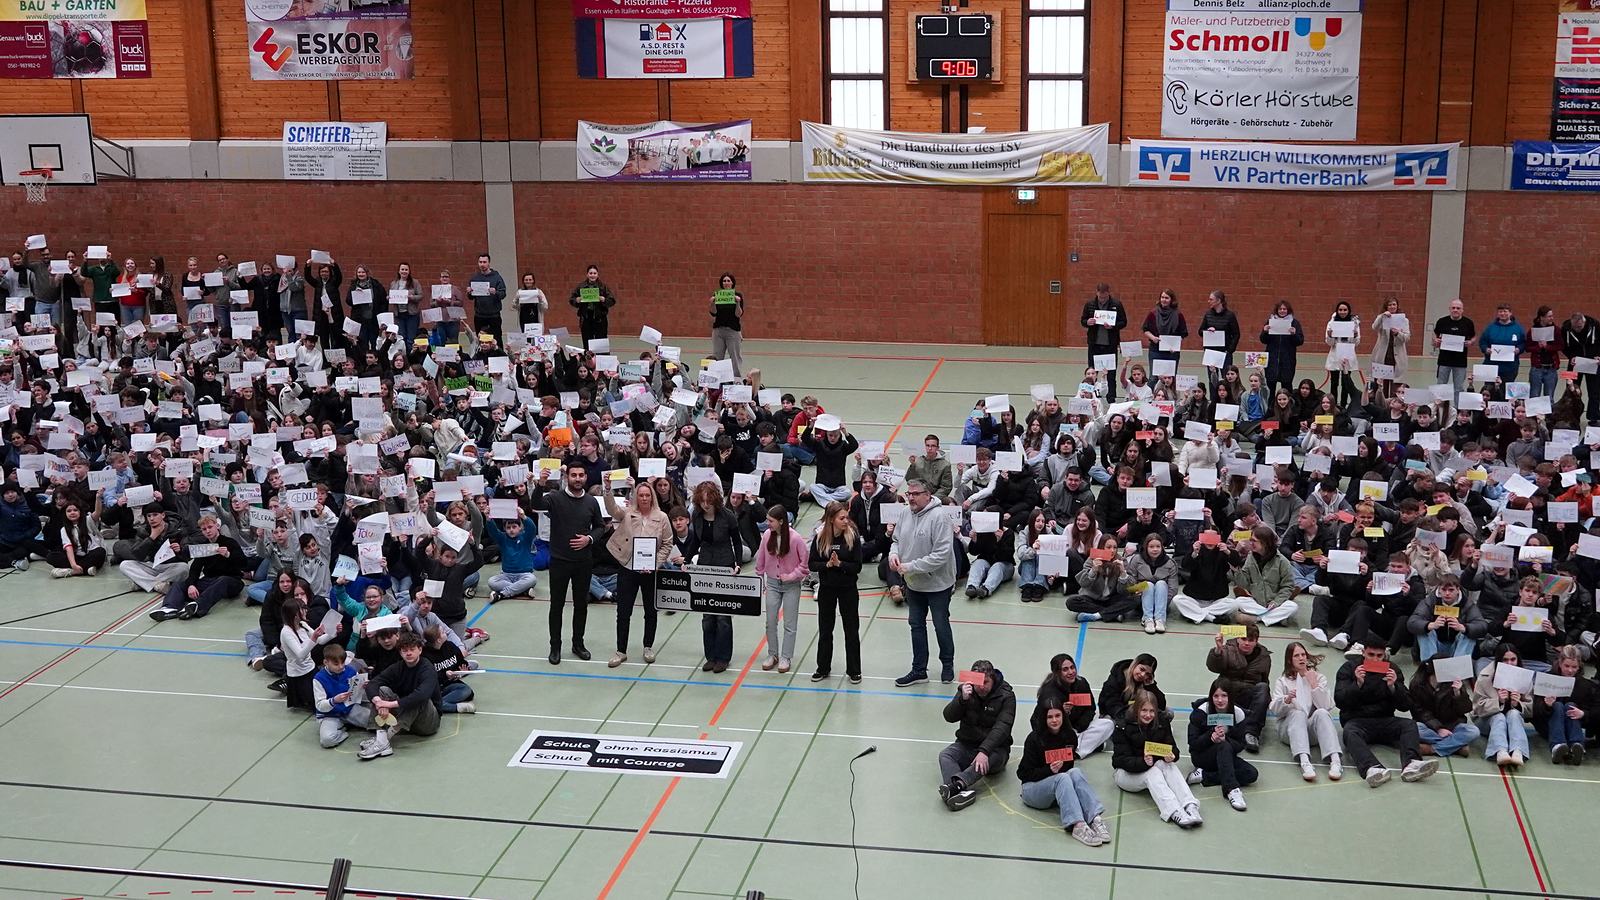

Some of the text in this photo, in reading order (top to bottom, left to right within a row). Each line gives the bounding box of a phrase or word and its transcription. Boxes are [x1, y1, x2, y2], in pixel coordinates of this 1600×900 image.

[20, 0, 45, 11] BAU
[65, 0, 116, 11] GARTEN
[693, 6, 737, 14] 05665.922379
[1193, 0, 1331, 9] Dennis Belz allianz-ploch.de
[1170, 16, 1290, 26] Maler- und Putzbetrieb
[26, 32, 44, 41] buck
[297, 33, 380, 54] ESKOR
[1169, 29, 1290, 52] Schmoll
[121, 45, 142, 53] buck
[298, 55, 381, 65] WERBEAGENTUR
[942, 61, 975, 76] 9:06
[1194, 89, 1354, 109] Körler Hörstube
[1559, 101, 1590, 109] Sichere
[1190, 117, 1333, 128] Hörgeräte Gehörschutz Zubehör
[288, 126, 351, 143] SCHEFFER
[881, 140, 902, 152] Die
[905, 140, 972, 153] Handballer
[975, 141, 996, 152] des
[1000, 141, 1022, 152] TSV
[812, 147, 872, 170] Bitburger
[881, 157, 1021, 172] begrüßen Sie zum Heimspiel
[1200, 149, 1388, 166] HERZLICH WILLKOMMEN!
[1213, 166, 1368, 186] VR PartnerBank
[1490, 405, 1511, 417] FAIR
[661, 577, 756, 591] Schule ohne Rassismus
[661, 595, 687, 604] Schule
[708, 599, 742, 609] Courage
[543, 740, 718, 756] Schule ohne Rassismus
[533, 753, 685, 768] Schule mit Courage
